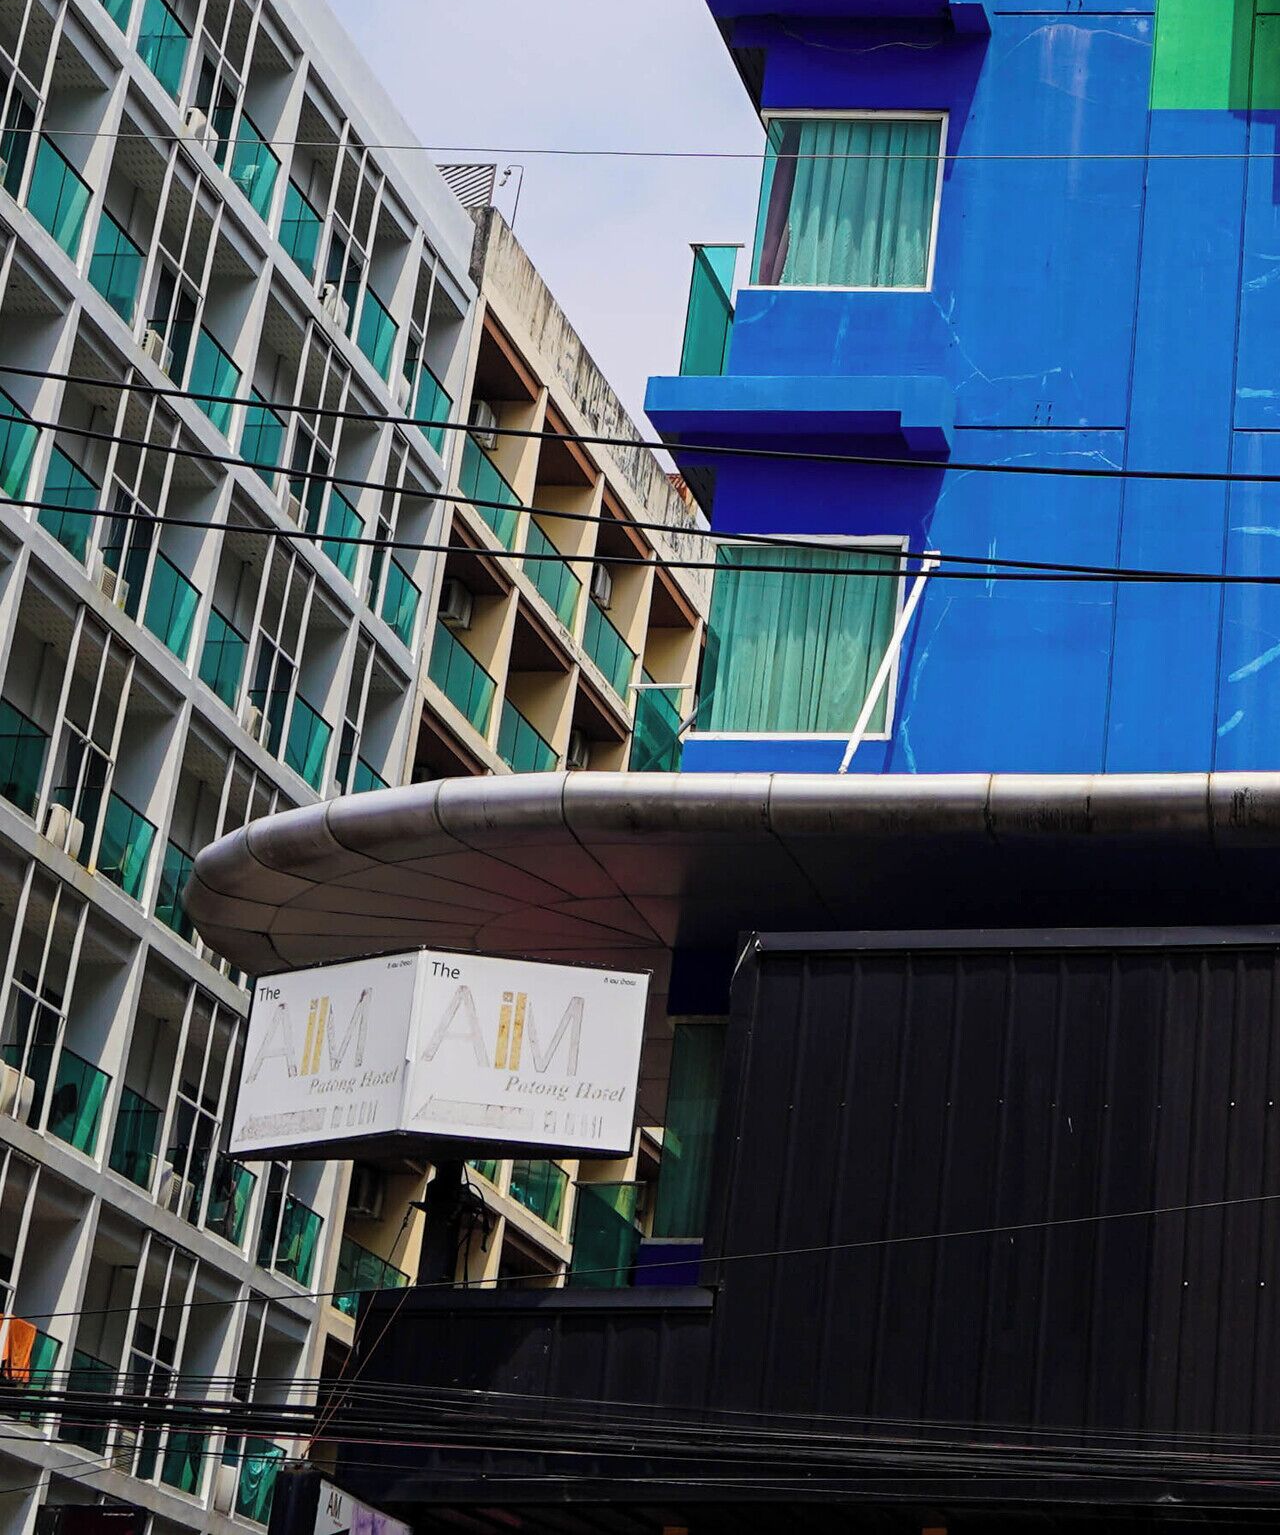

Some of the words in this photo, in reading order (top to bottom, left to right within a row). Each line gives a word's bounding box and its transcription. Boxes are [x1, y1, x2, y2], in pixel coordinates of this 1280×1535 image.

[432, 962, 460, 979] The
[259, 986, 280, 1002] The
[309, 1076, 357, 1095] Patong
[360, 1065, 399, 1088] Hotel
[504, 1076, 569, 1101] Patong
[575, 1081, 626, 1103] Hotel
